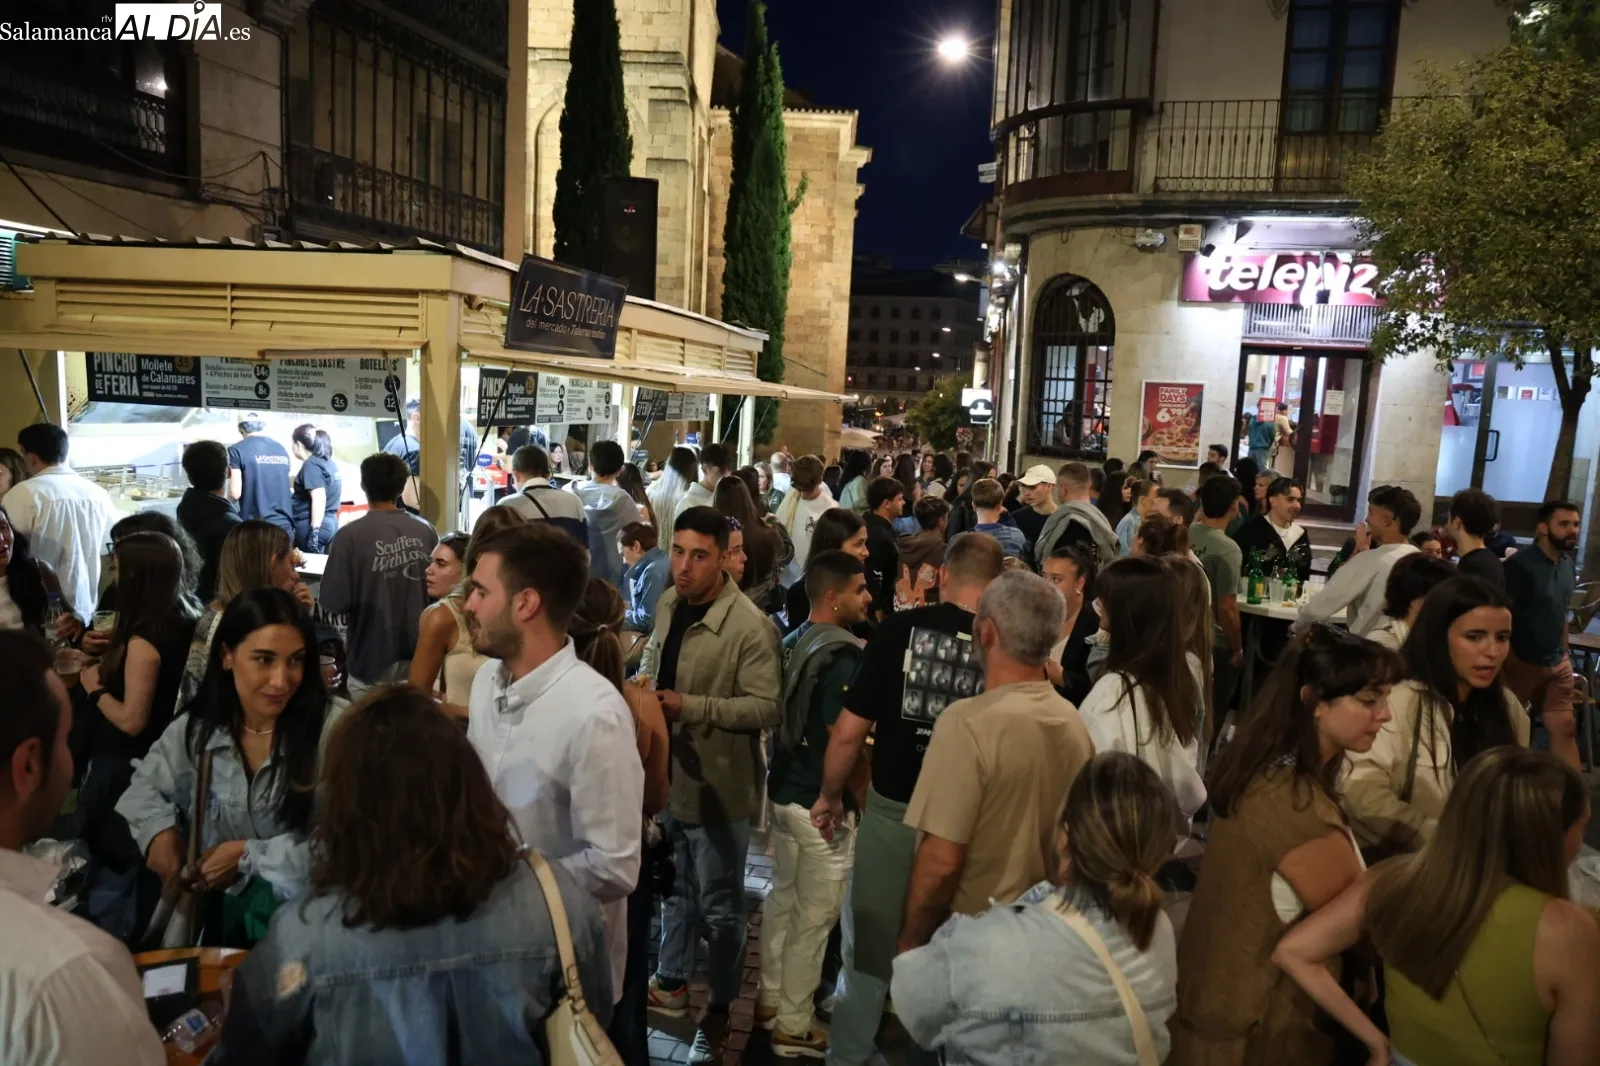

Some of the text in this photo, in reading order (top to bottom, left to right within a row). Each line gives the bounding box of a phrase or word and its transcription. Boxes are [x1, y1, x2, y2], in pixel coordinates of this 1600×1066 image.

[518, 281, 543, 314] LA
[526, 317, 537, 328] del
[539, 320, 567, 334] mercado
[93, 352, 137, 374] PINCHO
[141, 358, 173, 371] Mollete
[95, 378, 103, 389] DE
[104, 374, 139, 397] FERIA
[141, 371, 196, 385] de Calamares
[1160, 394, 1187, 402] DAYS
[375, 535, 424, 556] Scuffers
